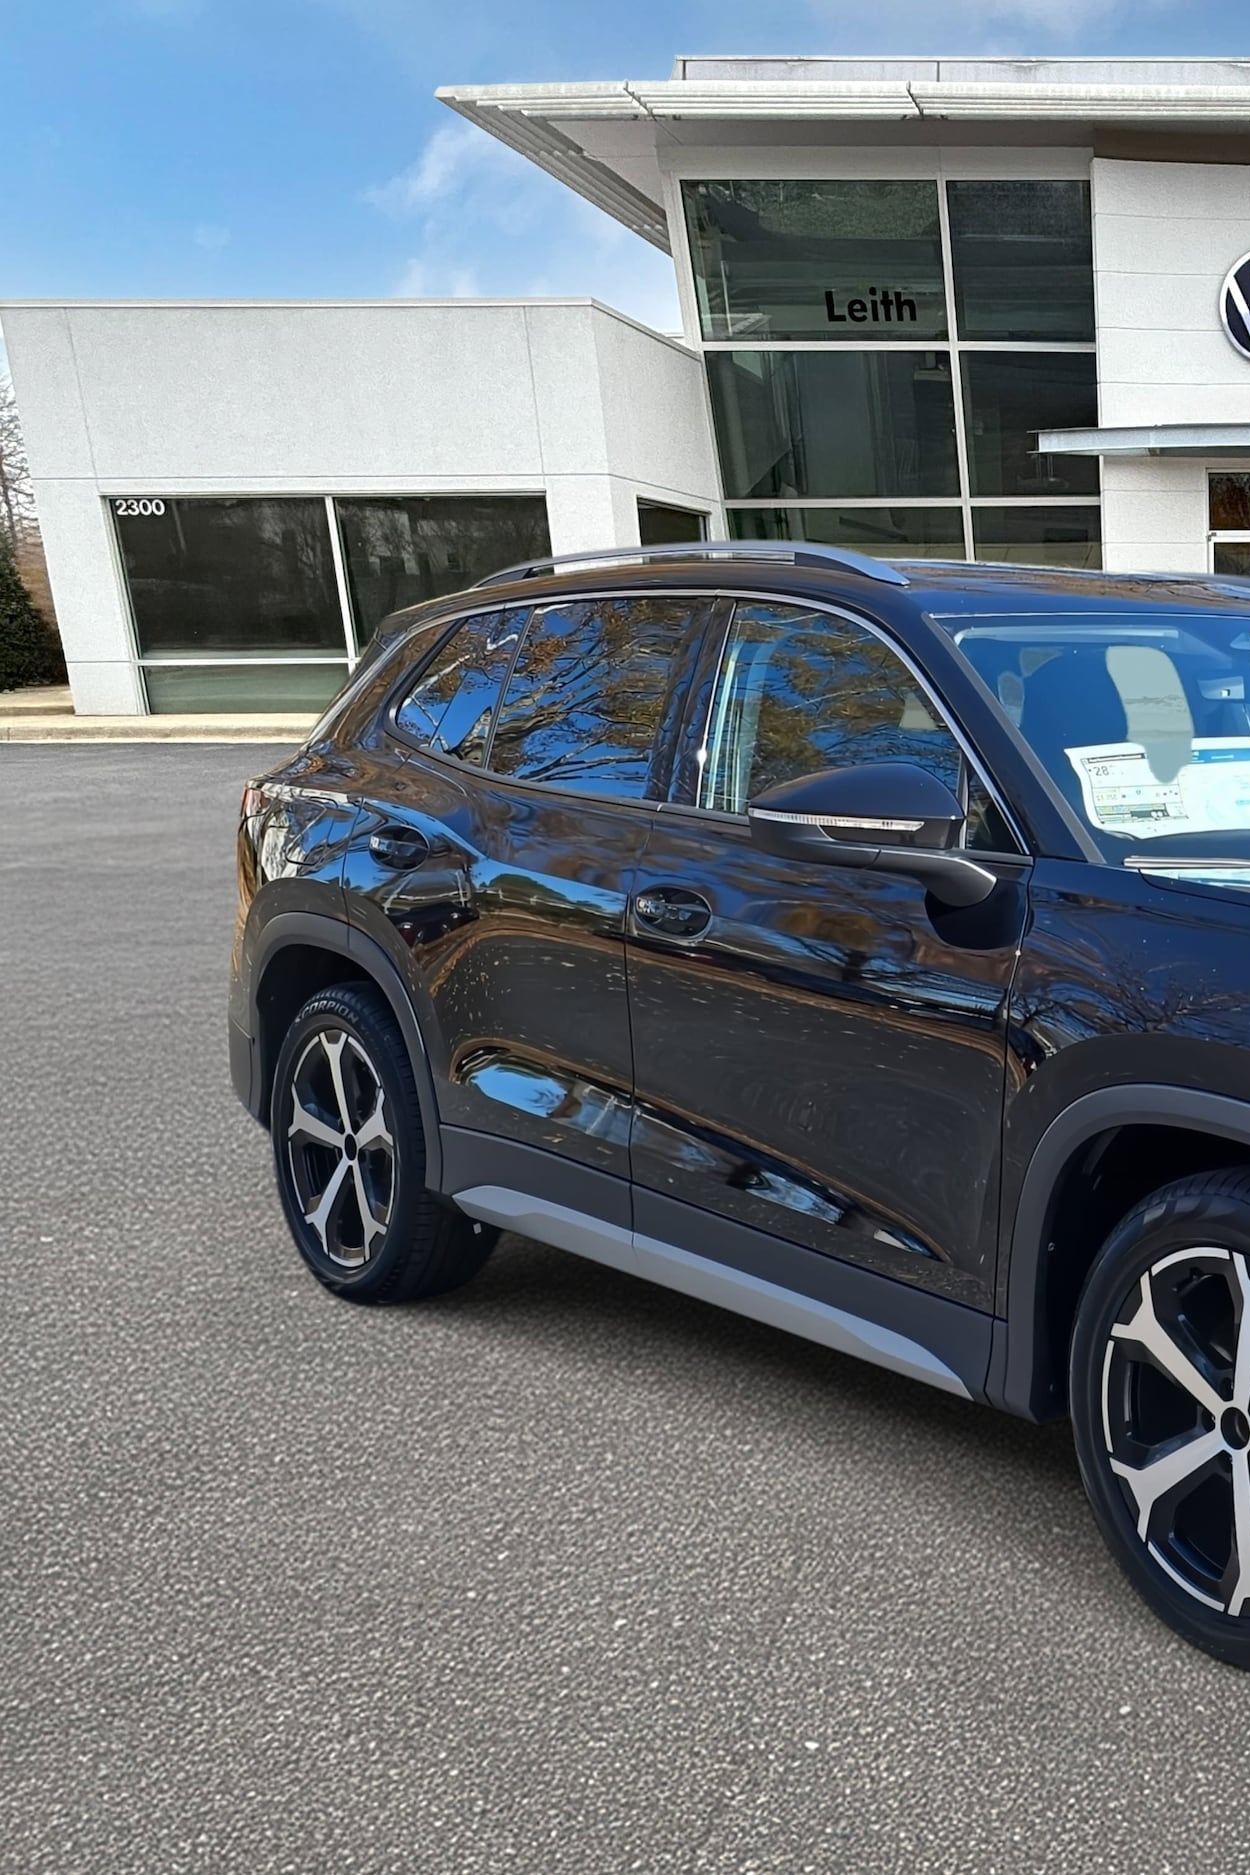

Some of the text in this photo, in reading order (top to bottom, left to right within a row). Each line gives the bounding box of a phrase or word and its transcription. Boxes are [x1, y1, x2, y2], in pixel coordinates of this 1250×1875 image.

[824, 286, 917, 323] Leith
[115, 499, 165, 516] 2300
[1093, 765, 1110, 777] 28
